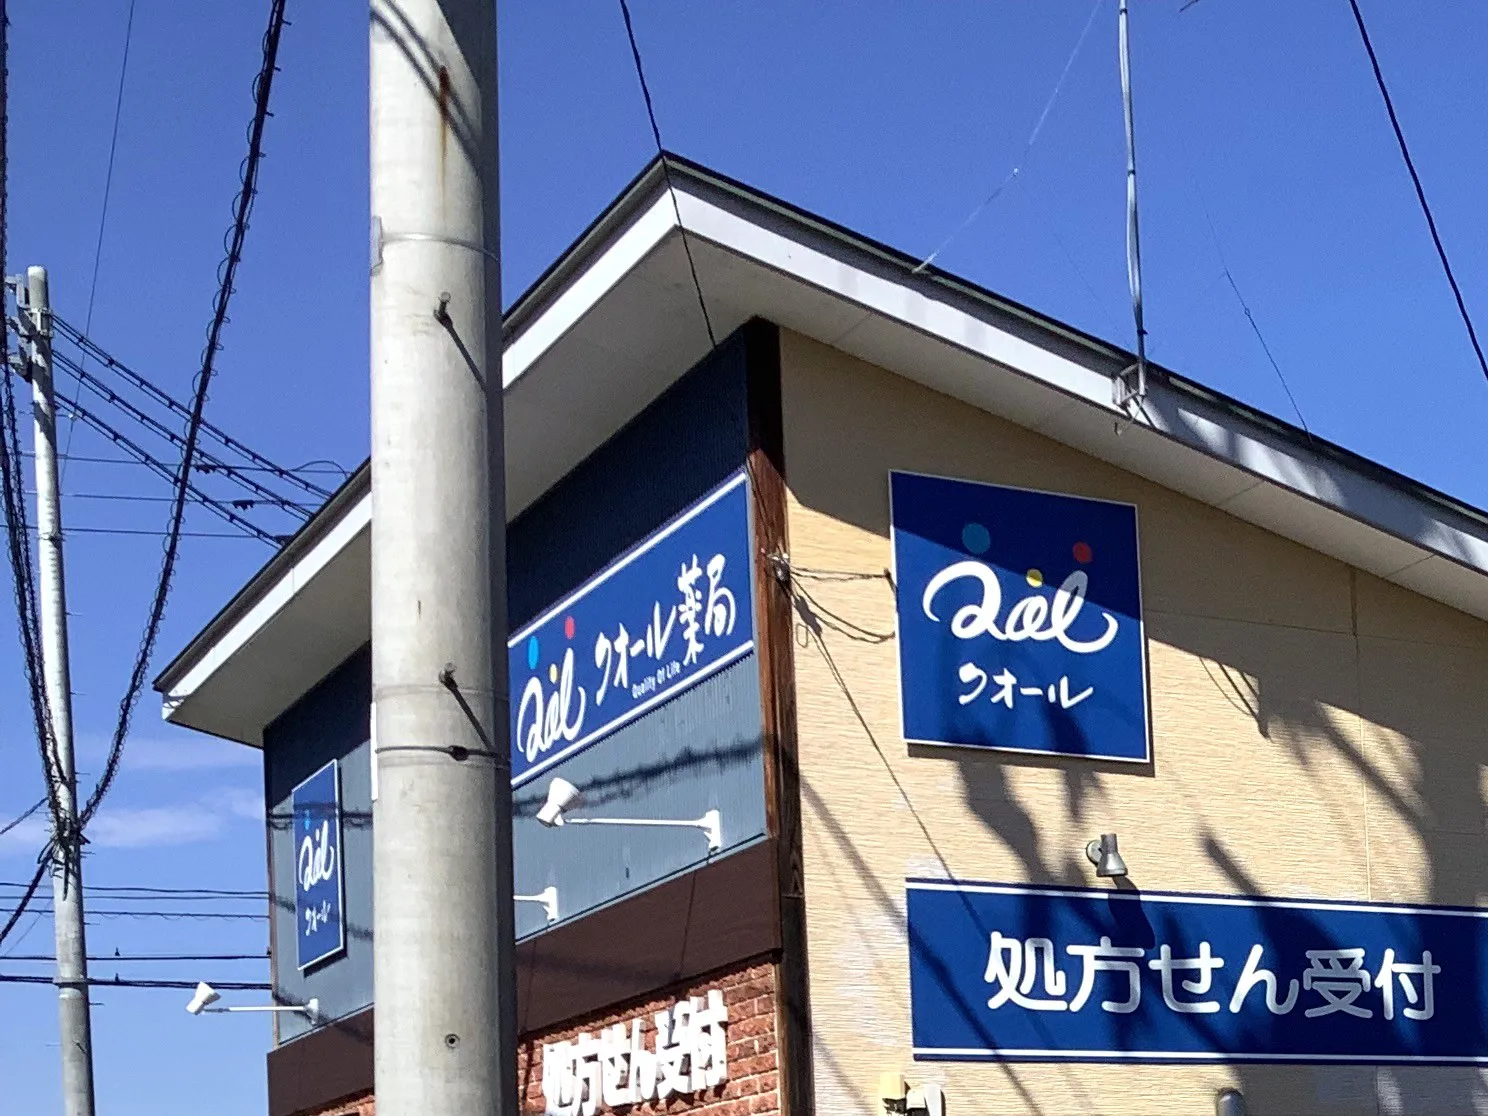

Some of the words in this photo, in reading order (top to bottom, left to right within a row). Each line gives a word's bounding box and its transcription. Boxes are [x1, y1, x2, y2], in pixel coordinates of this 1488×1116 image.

[595, 553, 736, 706] クオール薬局
[958, 663, 1094, 709] クオール
[984, 930, 1442, 1021] 処方せん受付
